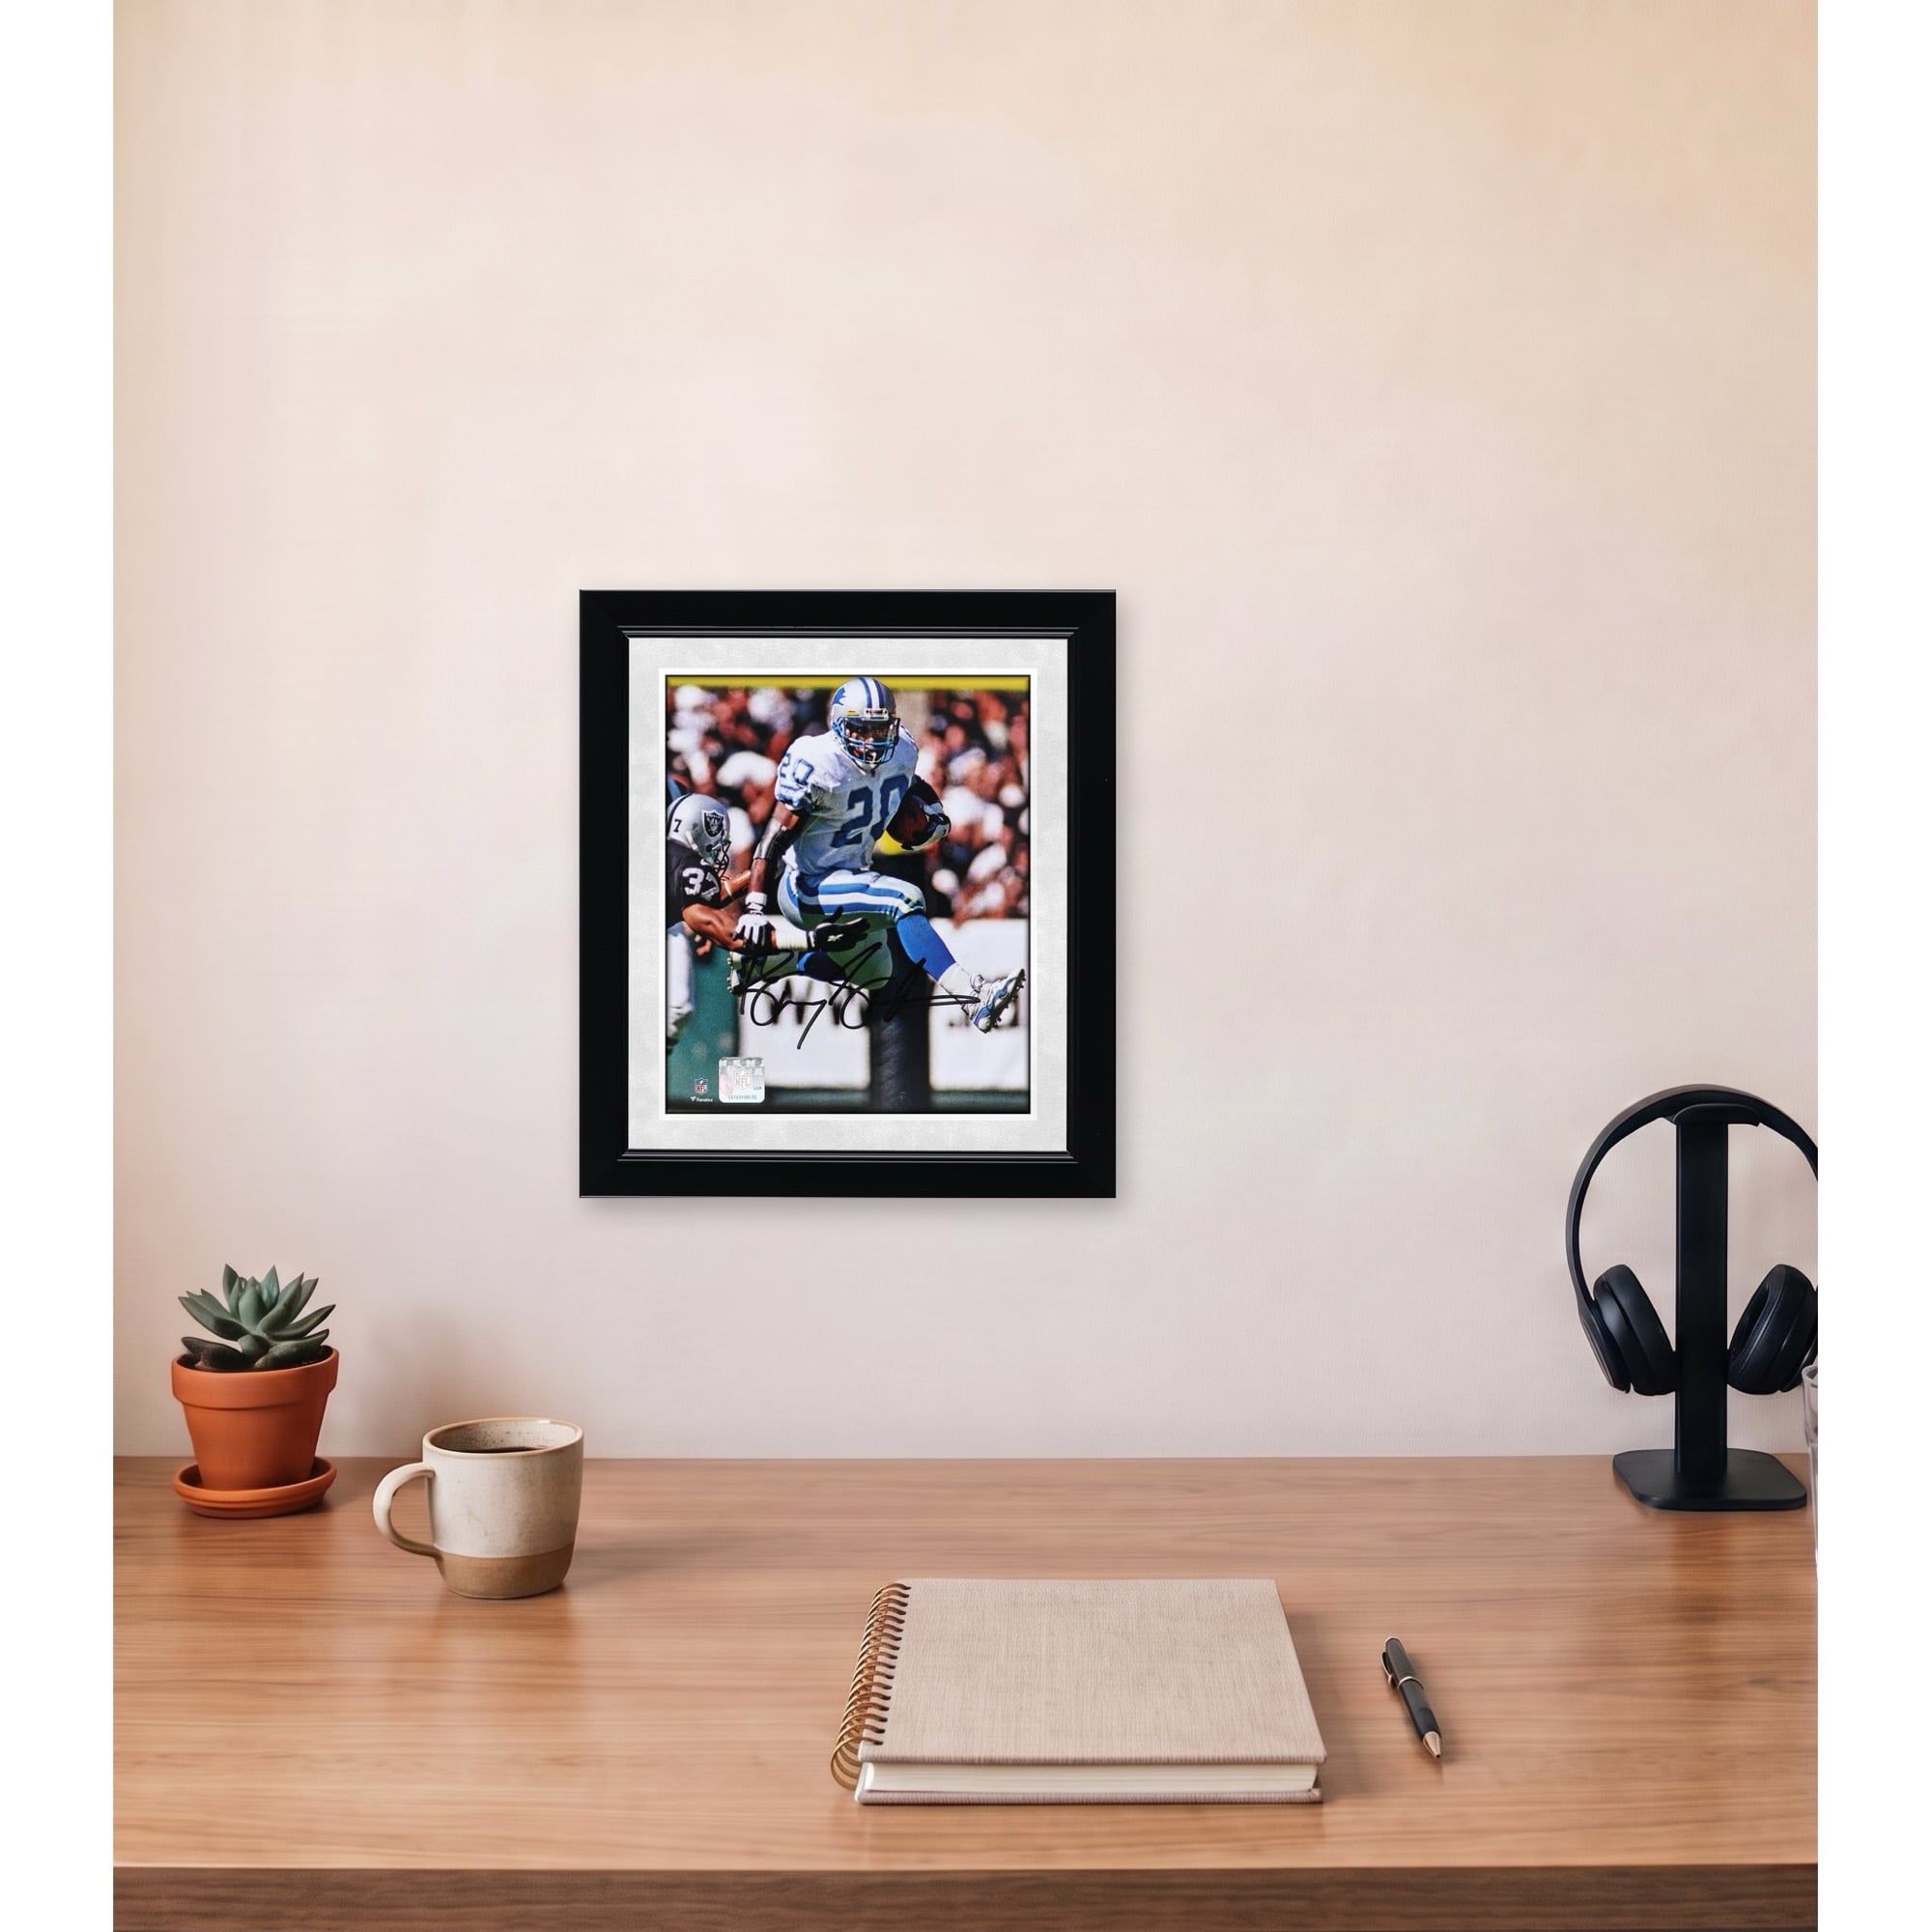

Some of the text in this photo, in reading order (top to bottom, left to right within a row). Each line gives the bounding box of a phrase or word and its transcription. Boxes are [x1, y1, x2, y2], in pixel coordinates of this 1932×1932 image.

[780, 753, 814, 784] 20
[831, 774, 909, 848] 20
[682, 867, 719, 901] 37
